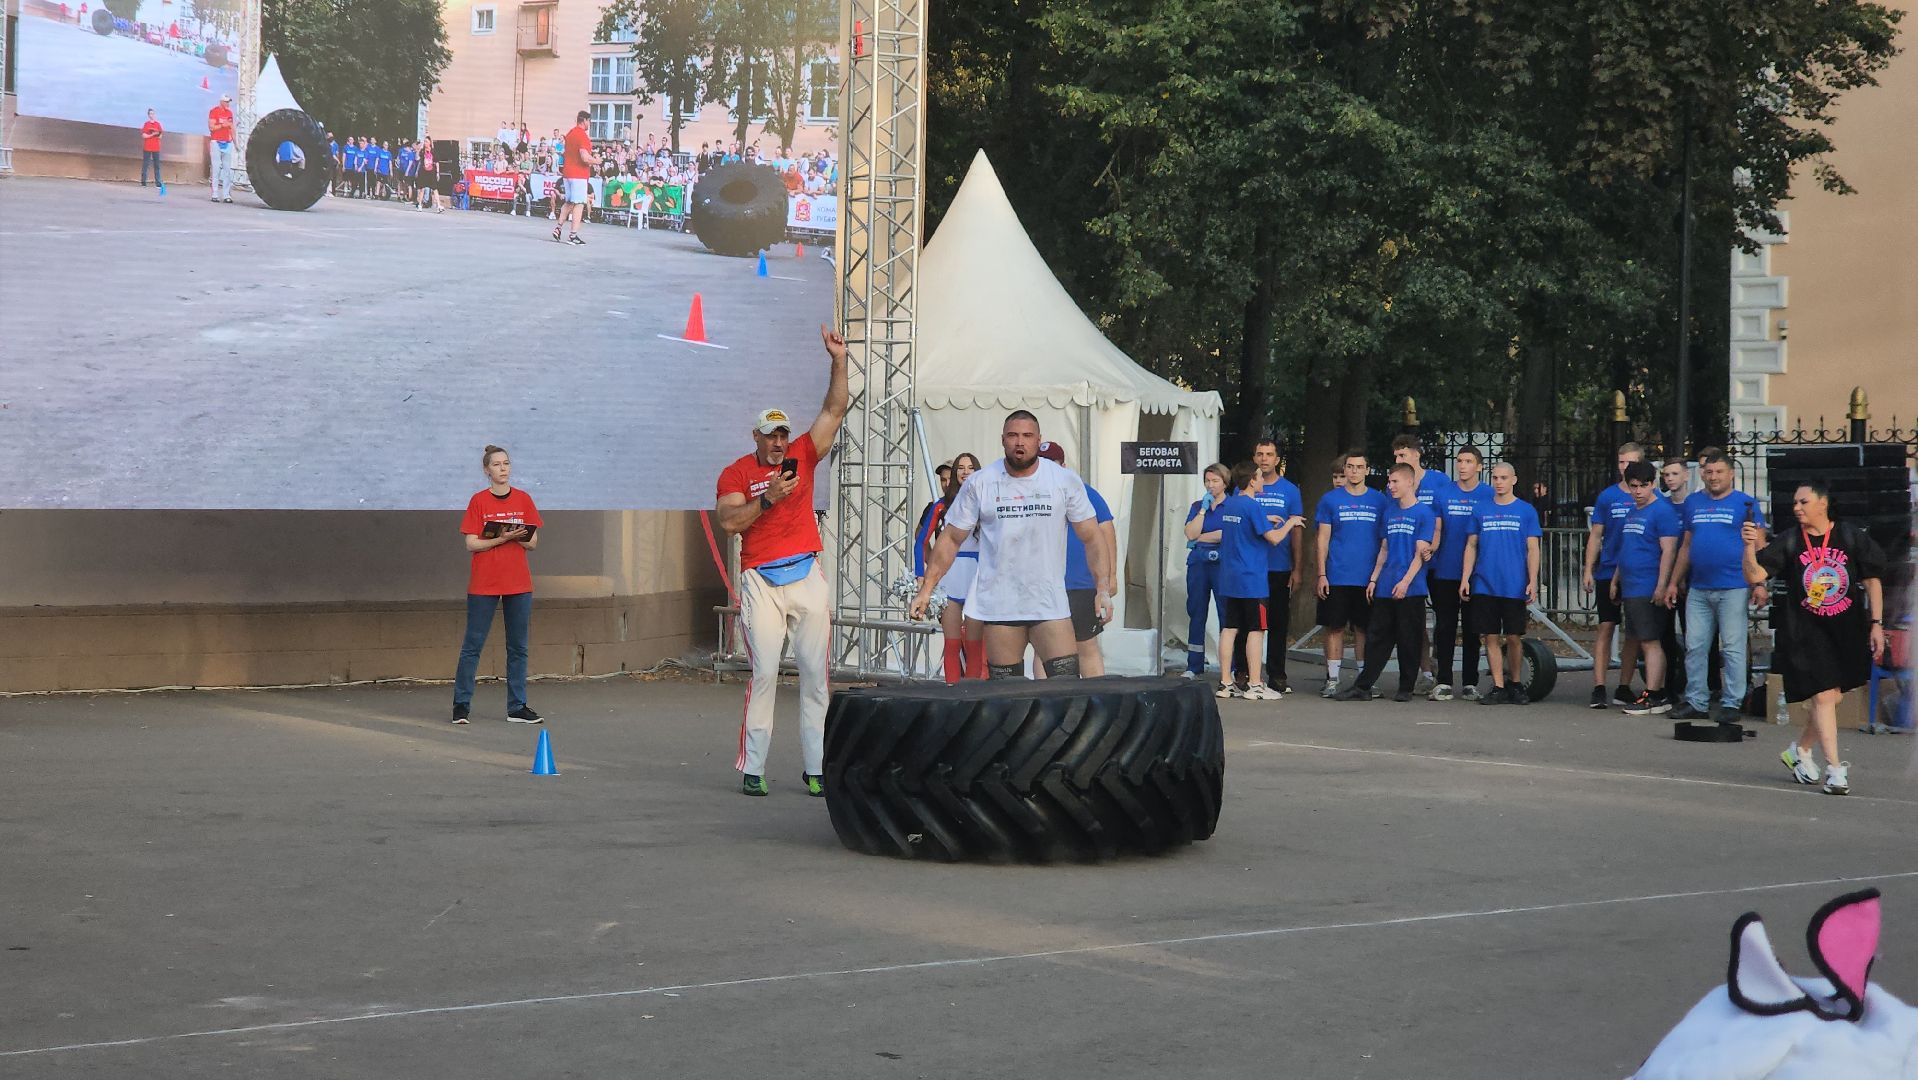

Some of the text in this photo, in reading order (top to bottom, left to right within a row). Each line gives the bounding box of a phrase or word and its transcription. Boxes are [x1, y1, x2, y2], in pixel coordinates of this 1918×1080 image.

[1139, 447, 1179, 456] БЕГОВАЯ
[1136, 458, 1182, 467] ЭСТАФЕТА
[996, 504, 1052, 512] ФЕСТИВАЛЬ
